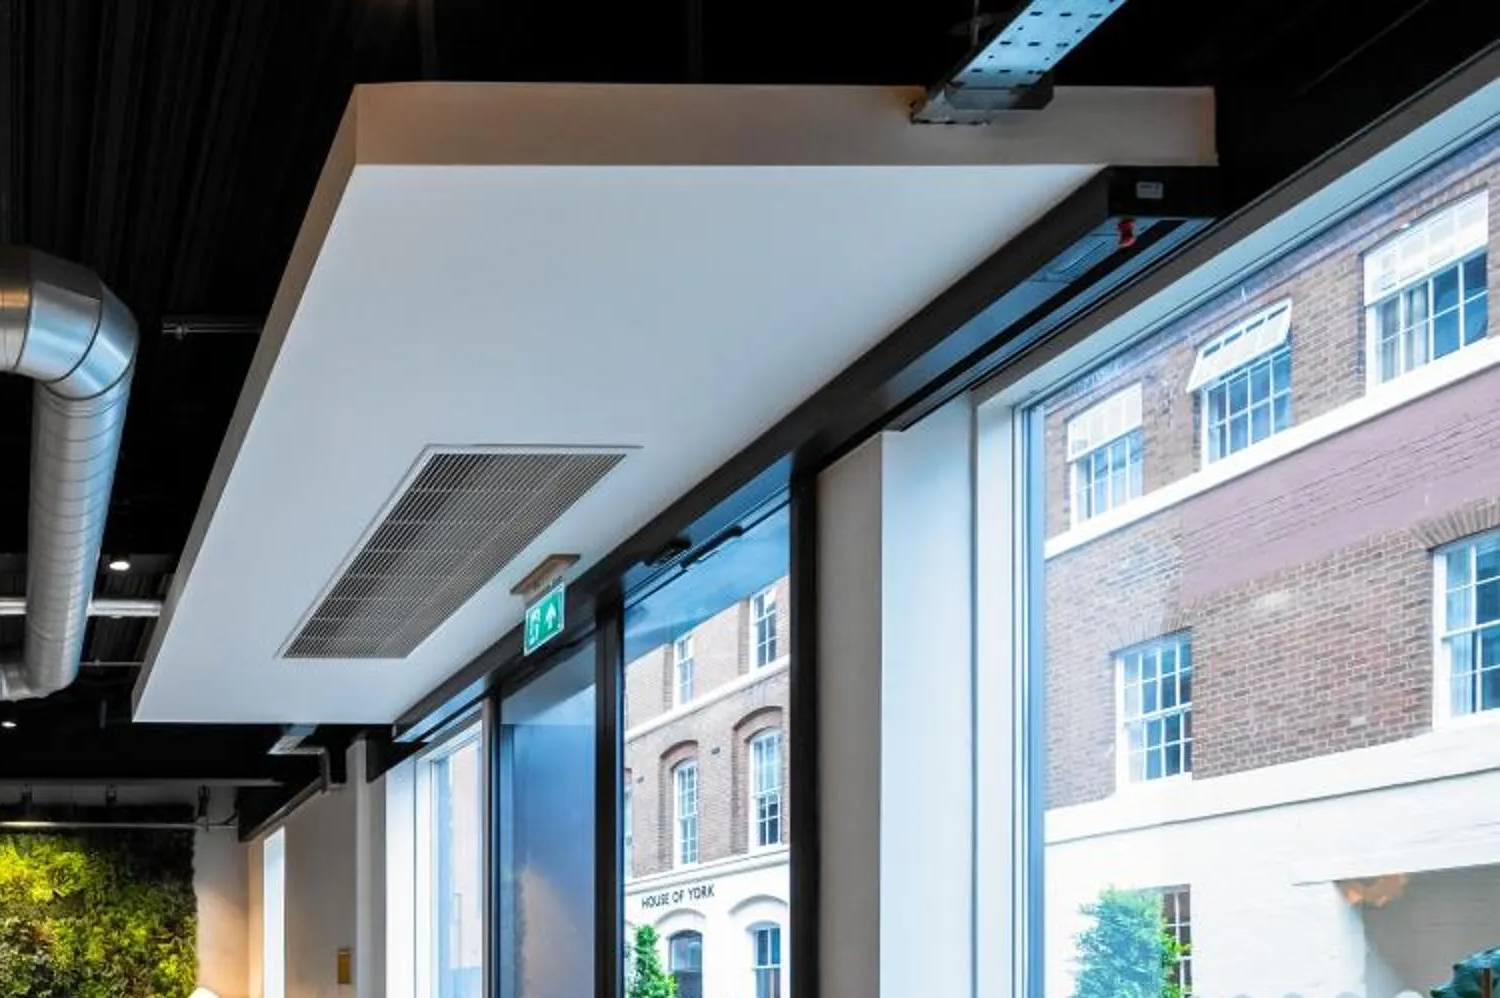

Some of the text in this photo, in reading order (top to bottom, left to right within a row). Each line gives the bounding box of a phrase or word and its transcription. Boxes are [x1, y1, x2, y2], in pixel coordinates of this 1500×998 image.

[641, 884, 715, 910] HOUSE OF YORK
